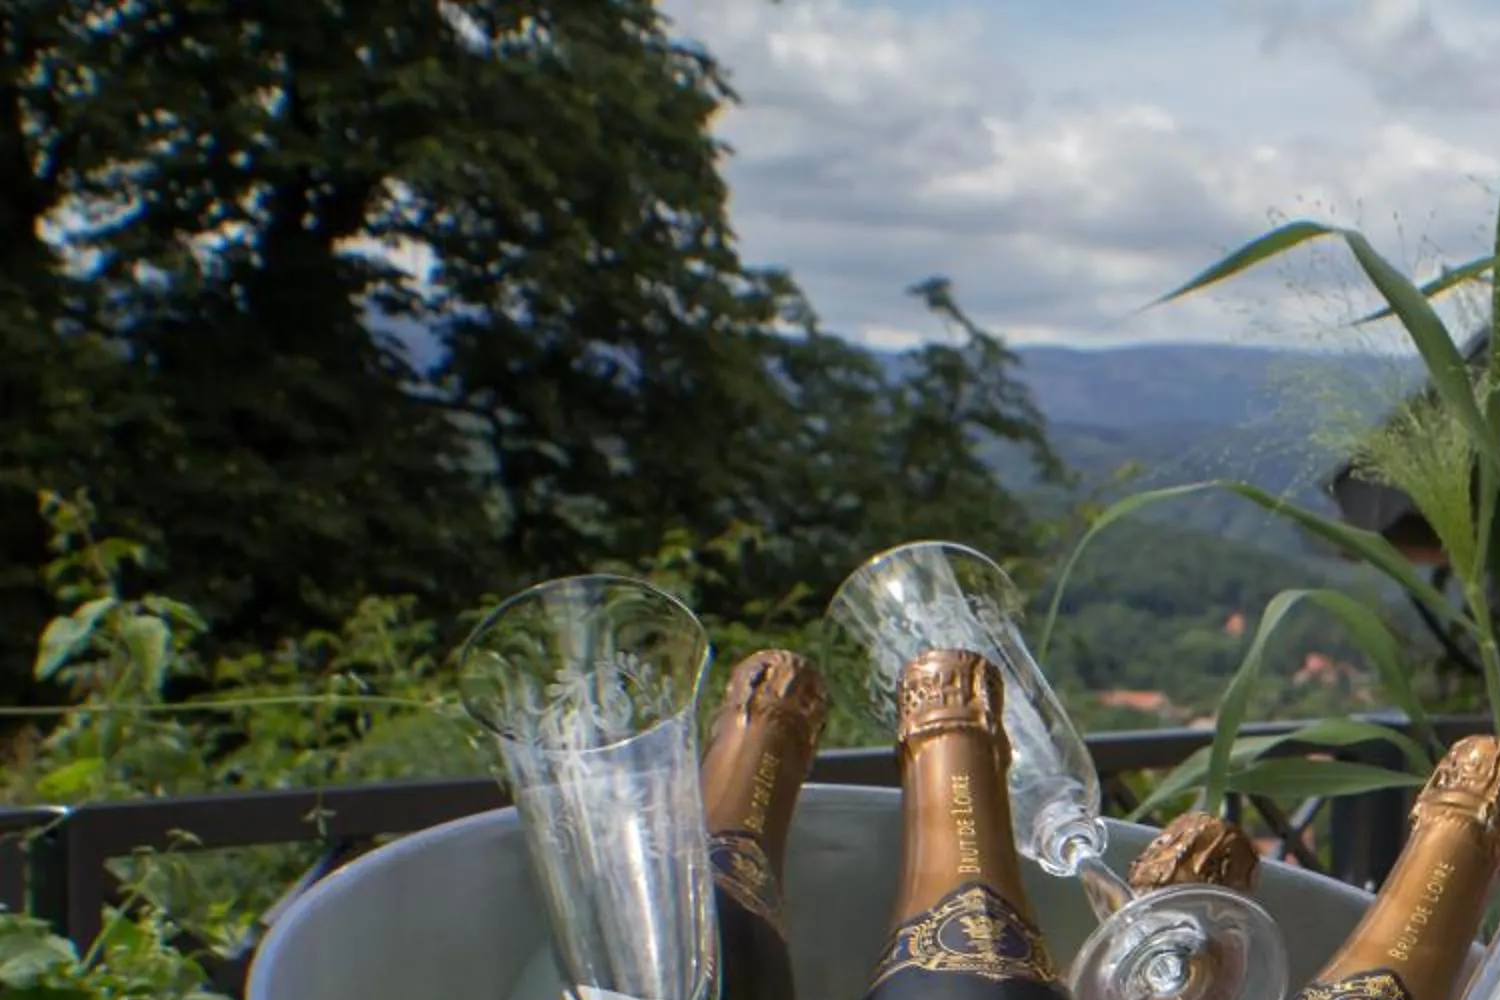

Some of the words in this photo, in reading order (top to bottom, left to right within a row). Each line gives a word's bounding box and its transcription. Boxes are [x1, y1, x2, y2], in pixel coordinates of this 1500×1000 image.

[950, 775, 973, 815] LOIRE
[956, 820, 976, 836] DE
[958, 840, 981, 873] BRUT
[1388, 924, 1418, 961] BRUT
[1411, 905, 1433, 926] DE
[1422, 862, 1455, 903] LOIRE
